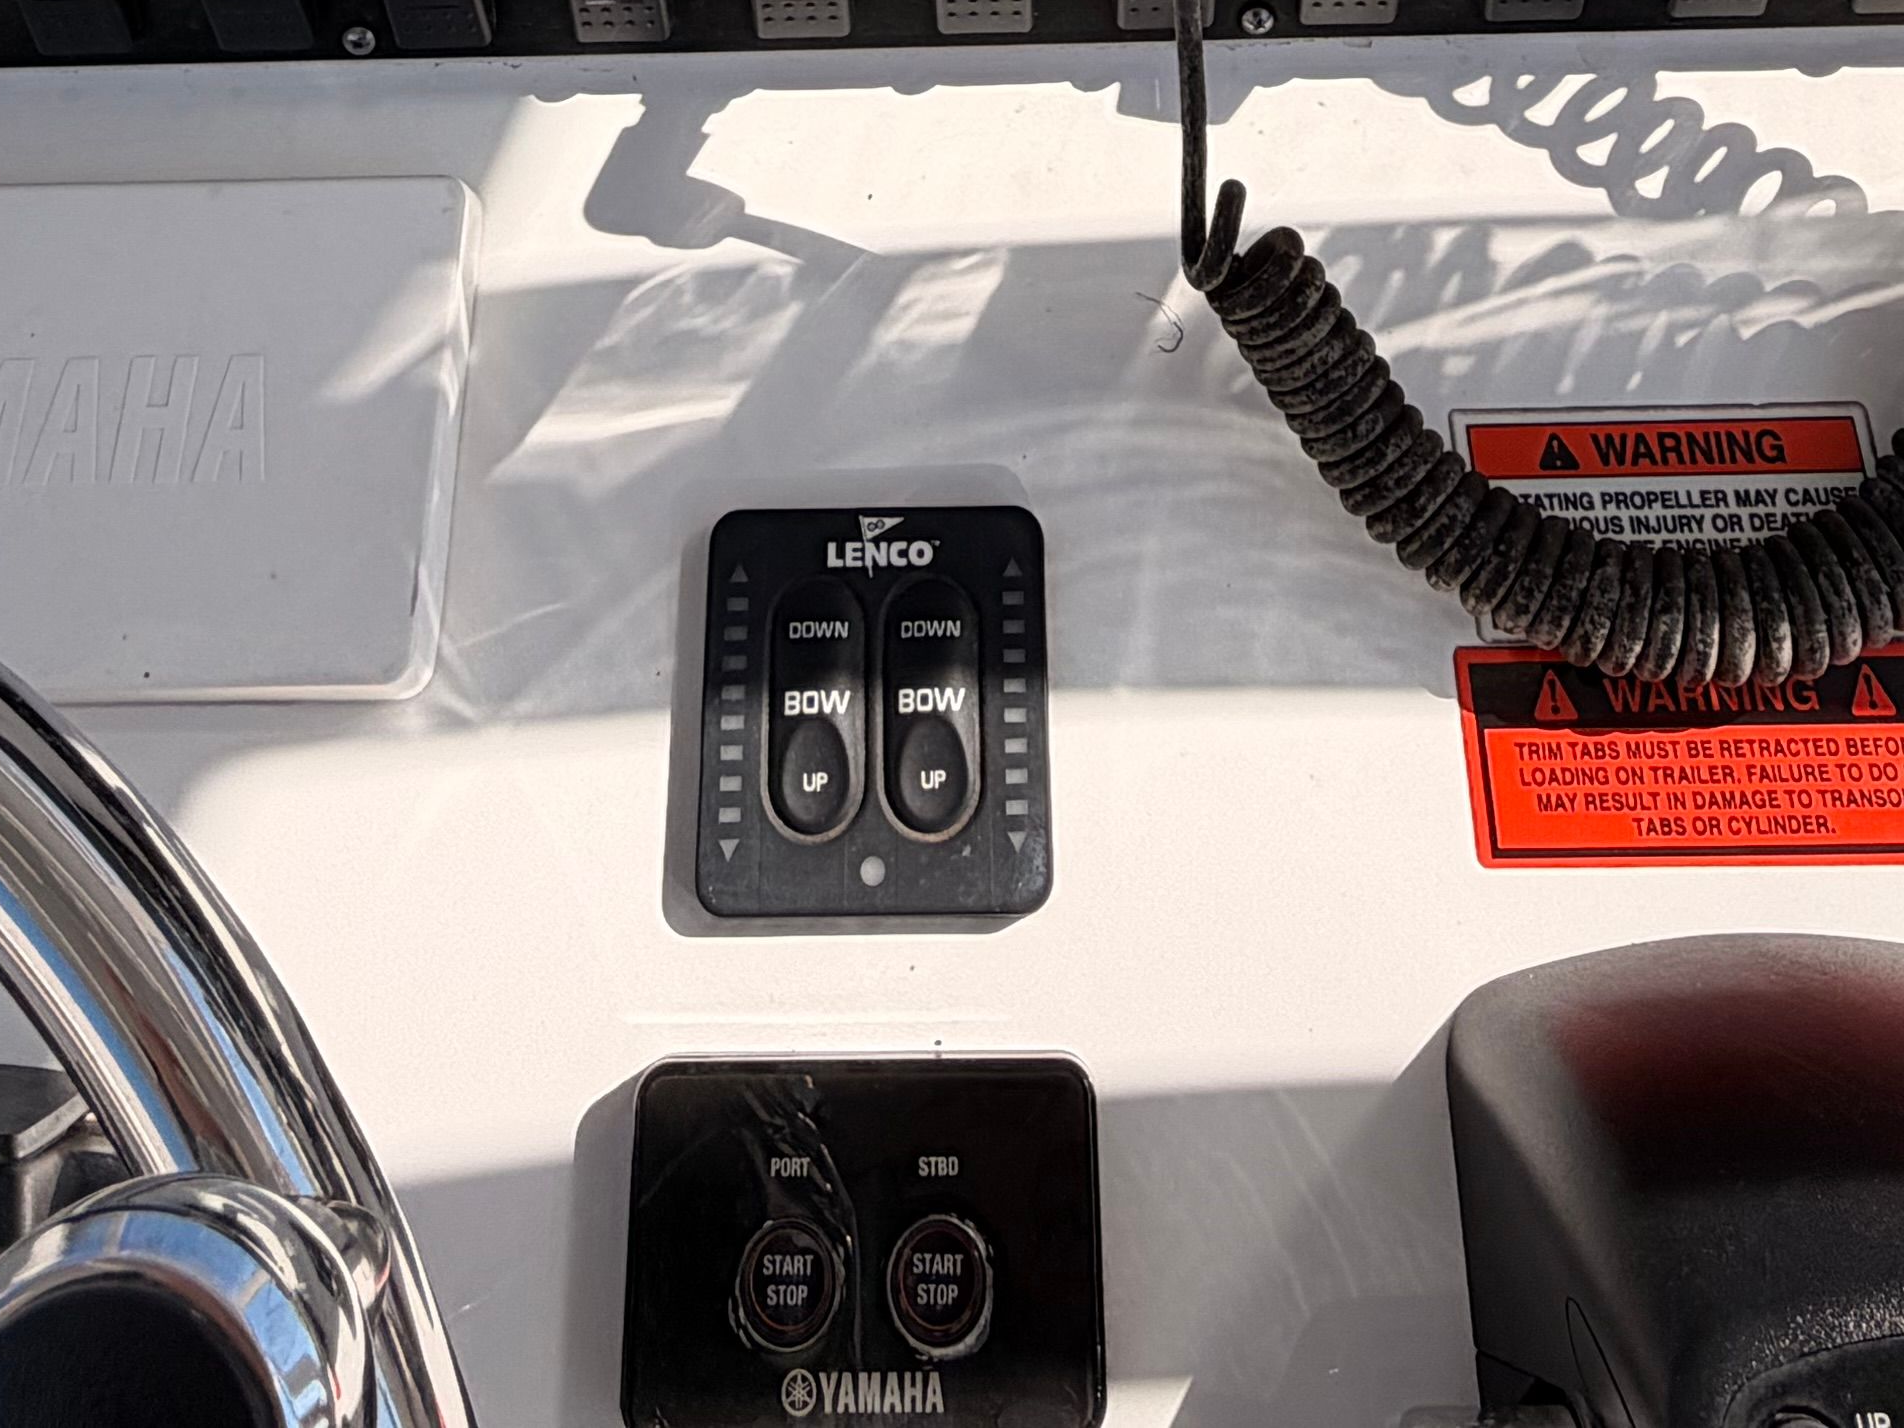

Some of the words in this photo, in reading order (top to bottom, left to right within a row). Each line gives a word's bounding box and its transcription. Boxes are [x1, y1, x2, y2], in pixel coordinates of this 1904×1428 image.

[1590, 429, 1787, 468] WARNING
[1519, 490, 1593, 513] TATING
[1601, 489, 1728, 511] PROPELLER
[1734, 488, 1777, 508] MAY
[1631, 513, 1705, 535] INJURY
[1711, 513, 1743, 533] OR
[1750, 512, 1813, 532] DEAT
[827, 540, 934, 567] LENCO
[789, 621, 849, 639] DOWN
[901, 620, 961, 638] DOWN
[784, 690, 851, 716] BOW
[898, 688, 965, 713] BOW
[1604, 676, 1821, 712] WARNING
[1514, 742, 1563, 761] TRIM
[1567, 741, 1620, 760] TABS
[1626, 740, 1680, 759] MUST
[1686, 740, 1714, 759] BE
[1719, 737, 1840, 758] RETRACTED
[803, 772, 828, 792] UP
[921, 769, 946, 790] UP
[1519, 767, 1610, 787] LOADING
[1615, 766, 1645, 786] ON
[1648, 764, 1741, 785] TRAILER.
[1746, 763, 1832, 783] FAILURE
[1835, 763, 1863, 782] TO
[1868, 762, 1898, 781] DO
[1537, 793, 1577, 812] MAY
[1584, 792, 1661, 811] RESULT
[1667, 791, 1687, 811] IN
[1693, 789, 1781, 810] DAMAGE
[1783, 789, 1812, 809] TO
[1632, 816, 1687, 836] TABS
[1692, 816, 1722, 835] OR
[1727, 815, 1837, 835] CYLINDER.
[770, 1157, 810, 1177] PORT
[918, 1156, 959, 1176] STBD
[762, 1253, 814, 1276] START
[912, 1253, 963, 1276] START
[766, 1284, 808, 1307] STOP
[917, 1283, 959, 1306] STOP
[818, 1371, 944, 1415] YAMAHA
